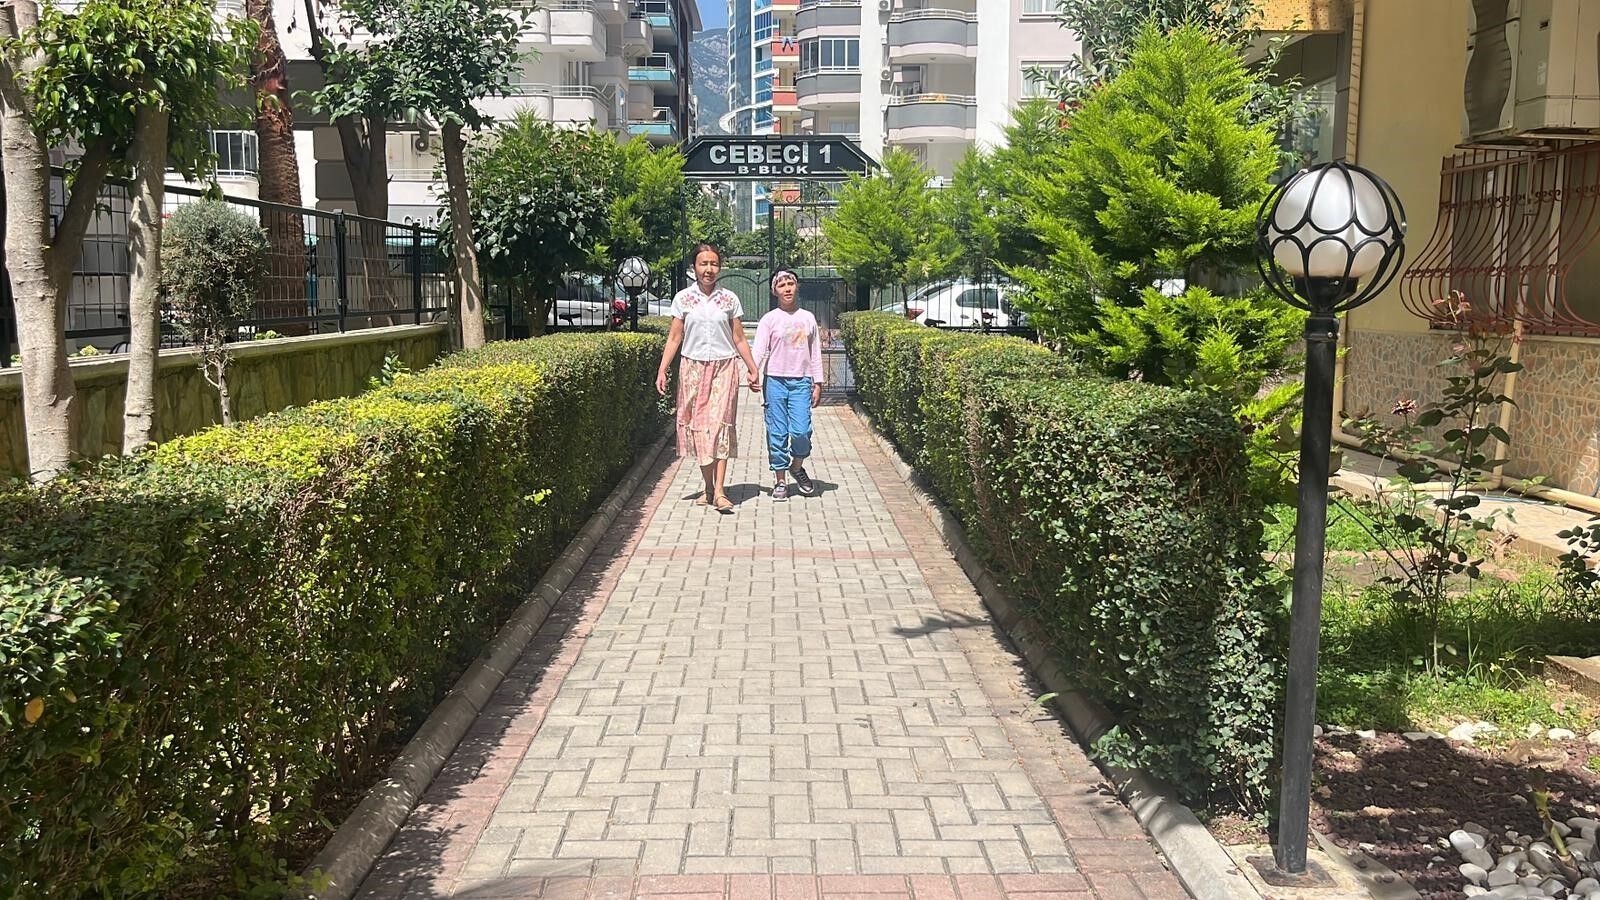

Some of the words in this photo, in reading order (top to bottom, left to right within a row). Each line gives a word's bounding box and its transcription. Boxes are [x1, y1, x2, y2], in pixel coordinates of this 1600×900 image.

[709, 142, 809, 164] CEBECİ
[819, 144, 831, 164] 1
[737, 165, 809, 174] B-BLOK
